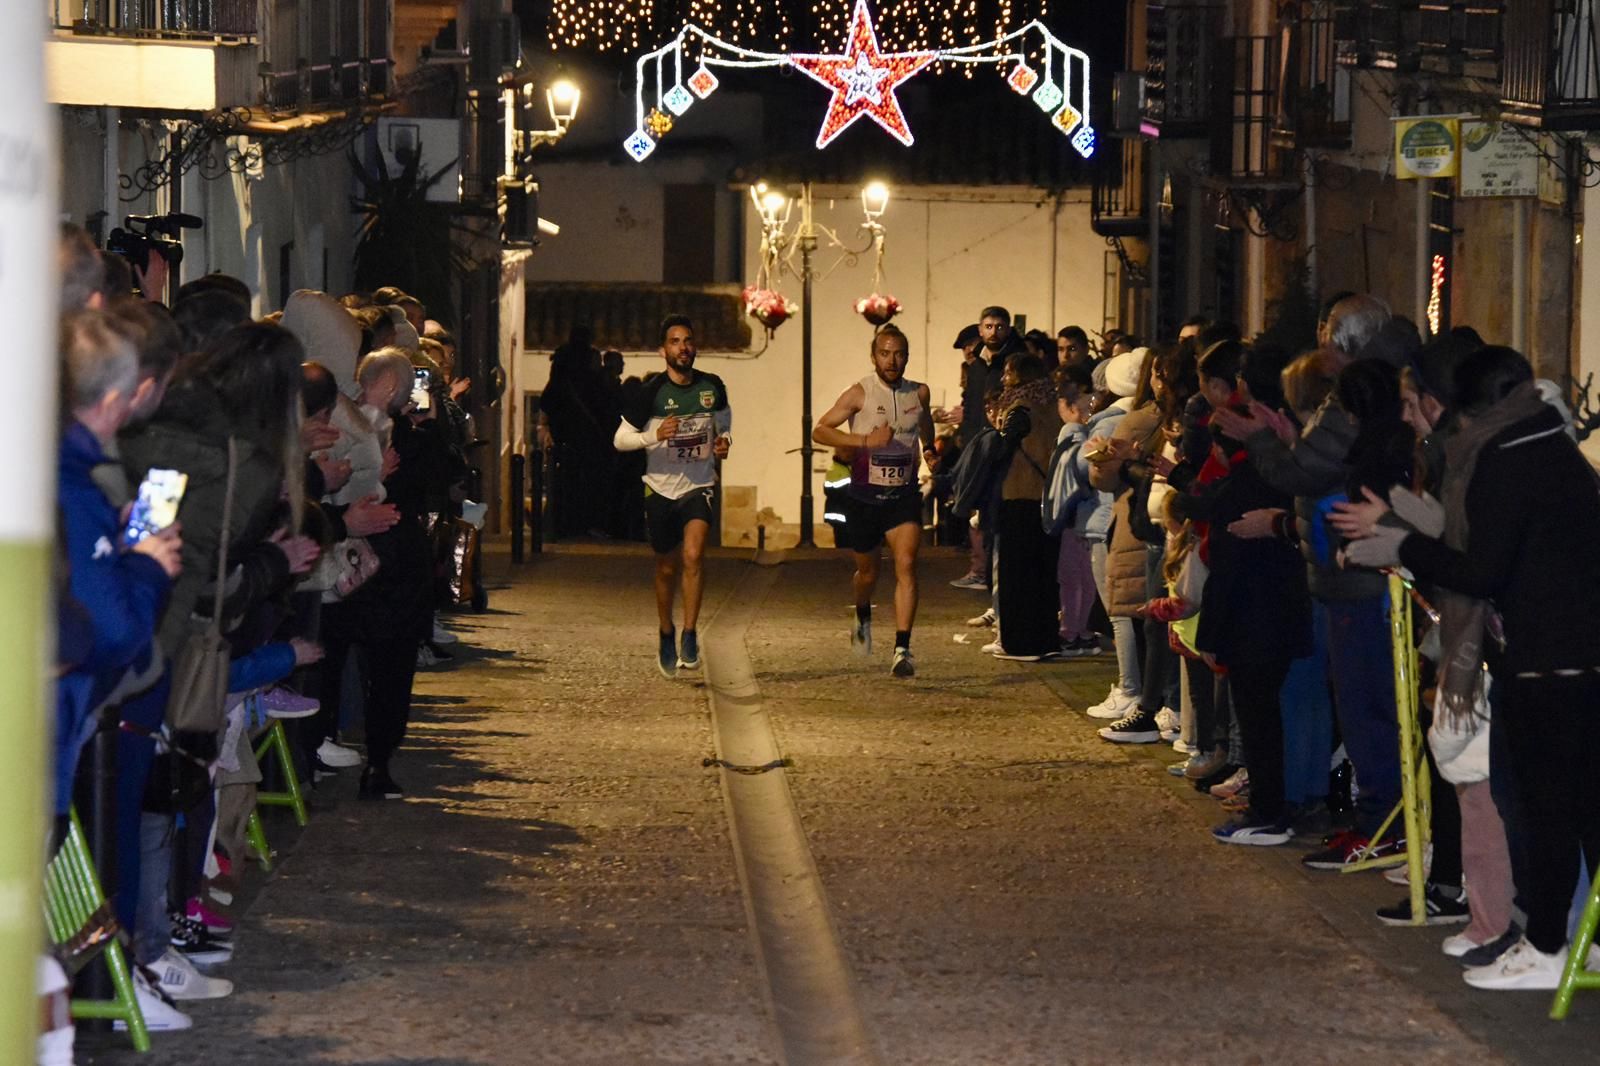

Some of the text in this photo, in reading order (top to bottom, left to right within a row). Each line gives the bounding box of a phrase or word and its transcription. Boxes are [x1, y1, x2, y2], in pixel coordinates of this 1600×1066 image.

[1417, 147, 1448, 157] ONCE
[677, 446, 701, 458] 271
[880, 467, 905, 478] 120
